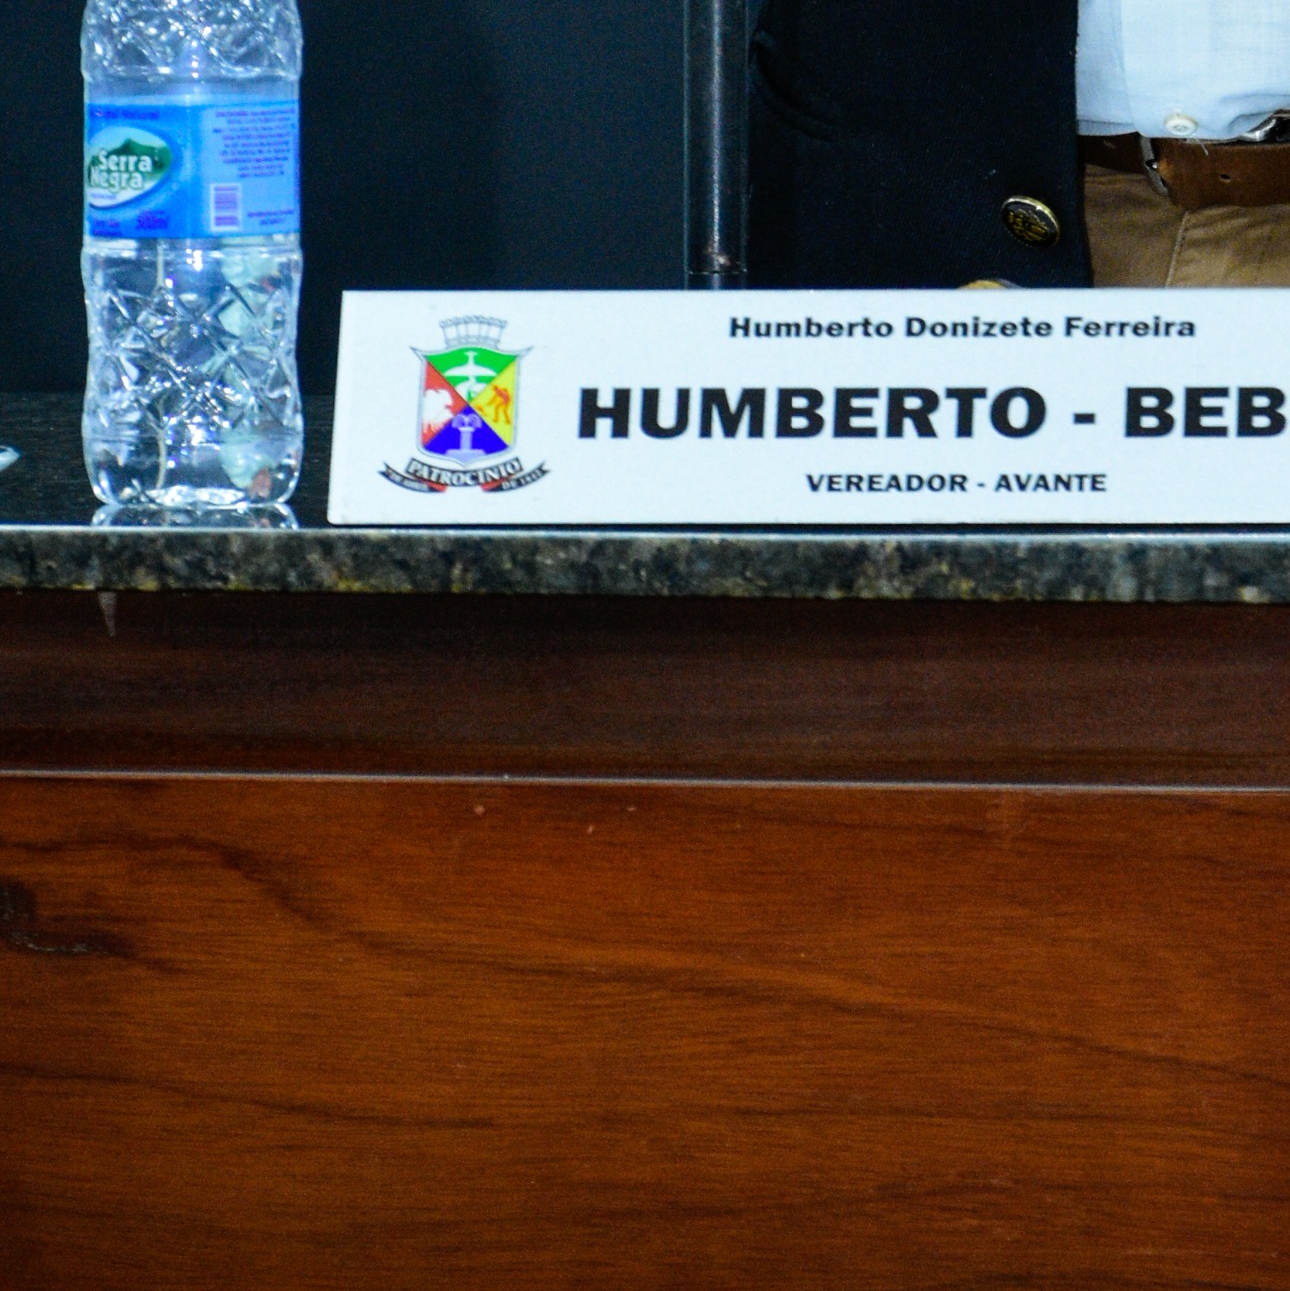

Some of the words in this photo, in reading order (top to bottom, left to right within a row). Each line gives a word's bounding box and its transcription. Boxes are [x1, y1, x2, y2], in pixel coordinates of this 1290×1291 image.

[97, 149, 152, 172] Serra
[89, 166, 143, 193] Negra
[730, 316, 894, 338] Humberto
[905, 316, 1053, 337] Donizete
[1065, 316, 1196, 337] Ferreira
[577, 386, 1047, 439] HUMBERTO
[1073, 412, 1096, 425] -
[806, 474, 968, 492] VEREADOR
[994, 474, 1107, 492] AVANTE
